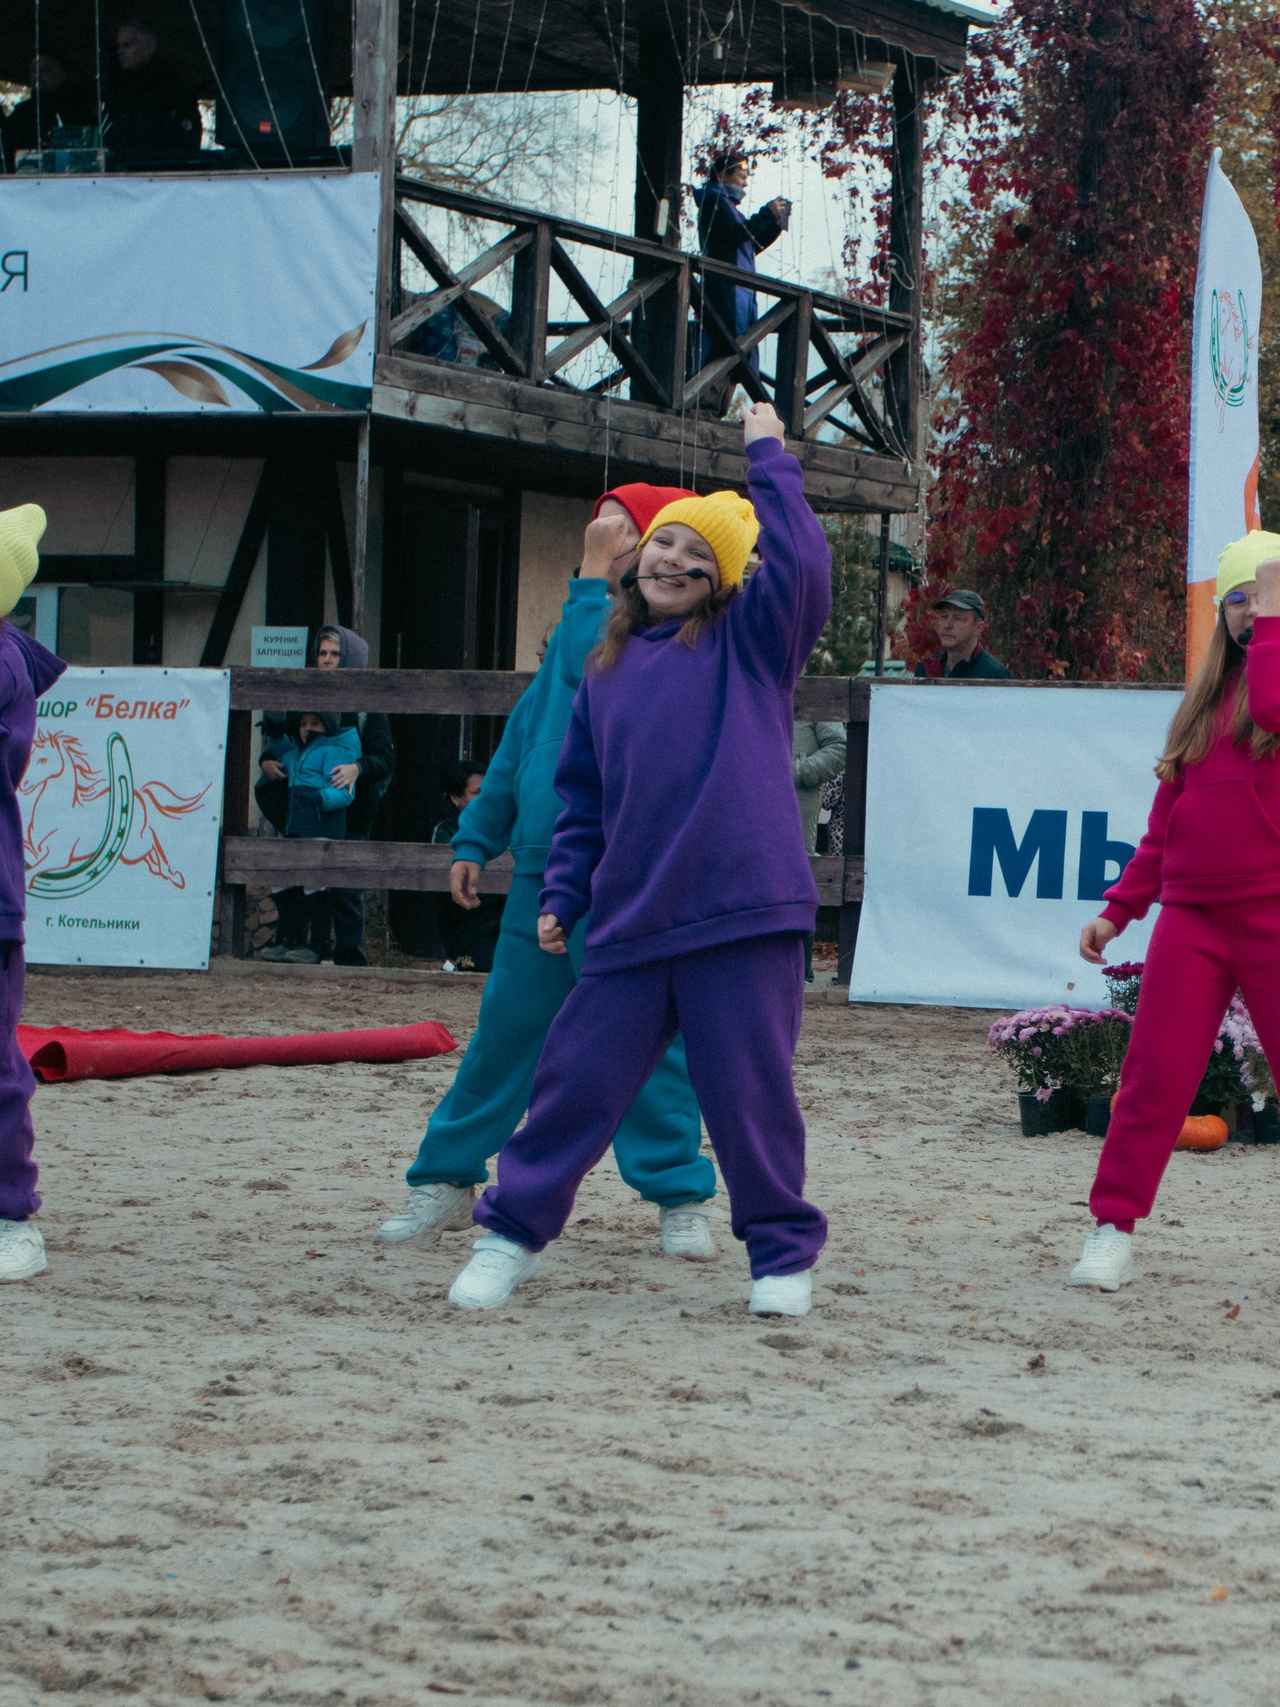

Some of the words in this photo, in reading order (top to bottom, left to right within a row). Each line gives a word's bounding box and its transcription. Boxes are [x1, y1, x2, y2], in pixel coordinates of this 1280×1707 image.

[264, 636, 298, 644] КУРЕНИЕ
[257, 648, 303, 657] ЗАПРЕЩЕНО
[36, 701, 78, 718] ШОР
[46, 916, 53, 927] г.
[58, 914, 140, 930] Котельники
